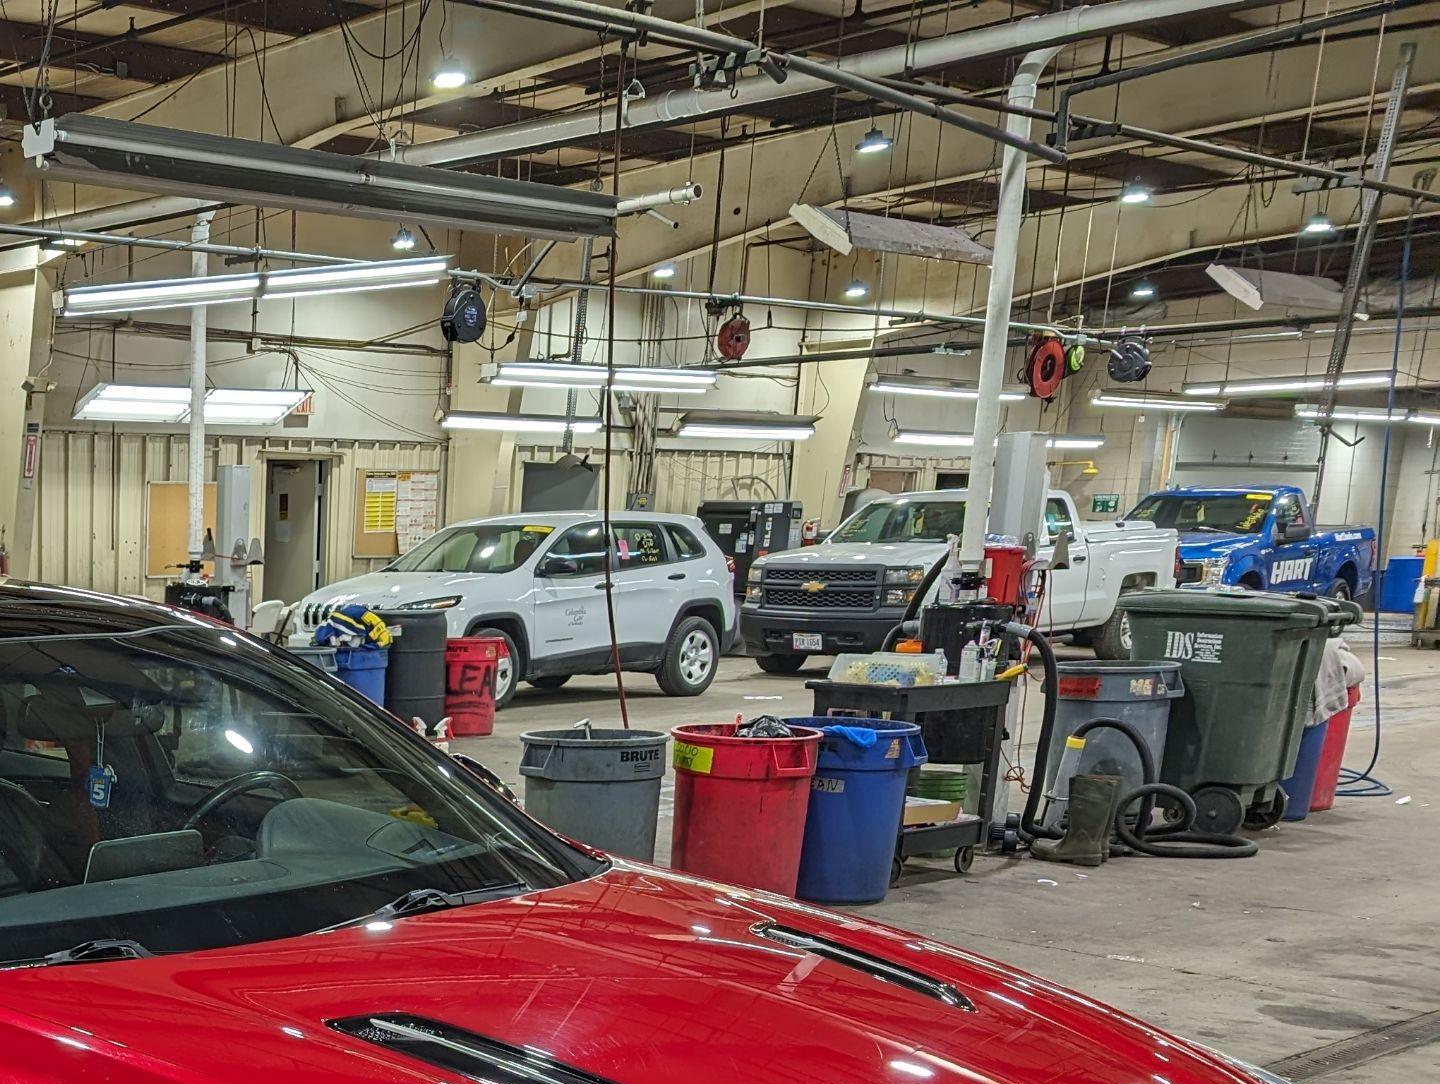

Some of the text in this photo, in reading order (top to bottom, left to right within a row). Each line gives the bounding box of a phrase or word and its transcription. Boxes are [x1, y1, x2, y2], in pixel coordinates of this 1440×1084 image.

[1270, 558, 1314, 585] HART
[447, 645, 469, 653] RUTE
[1164, 630, 1195, 660] IDS
[446, 663, 496, 698] LEA
[620, 749, 660, 763] BRUTE
[92, 783, 105, 800] 5
[810, 778, 839, 791] EAN
